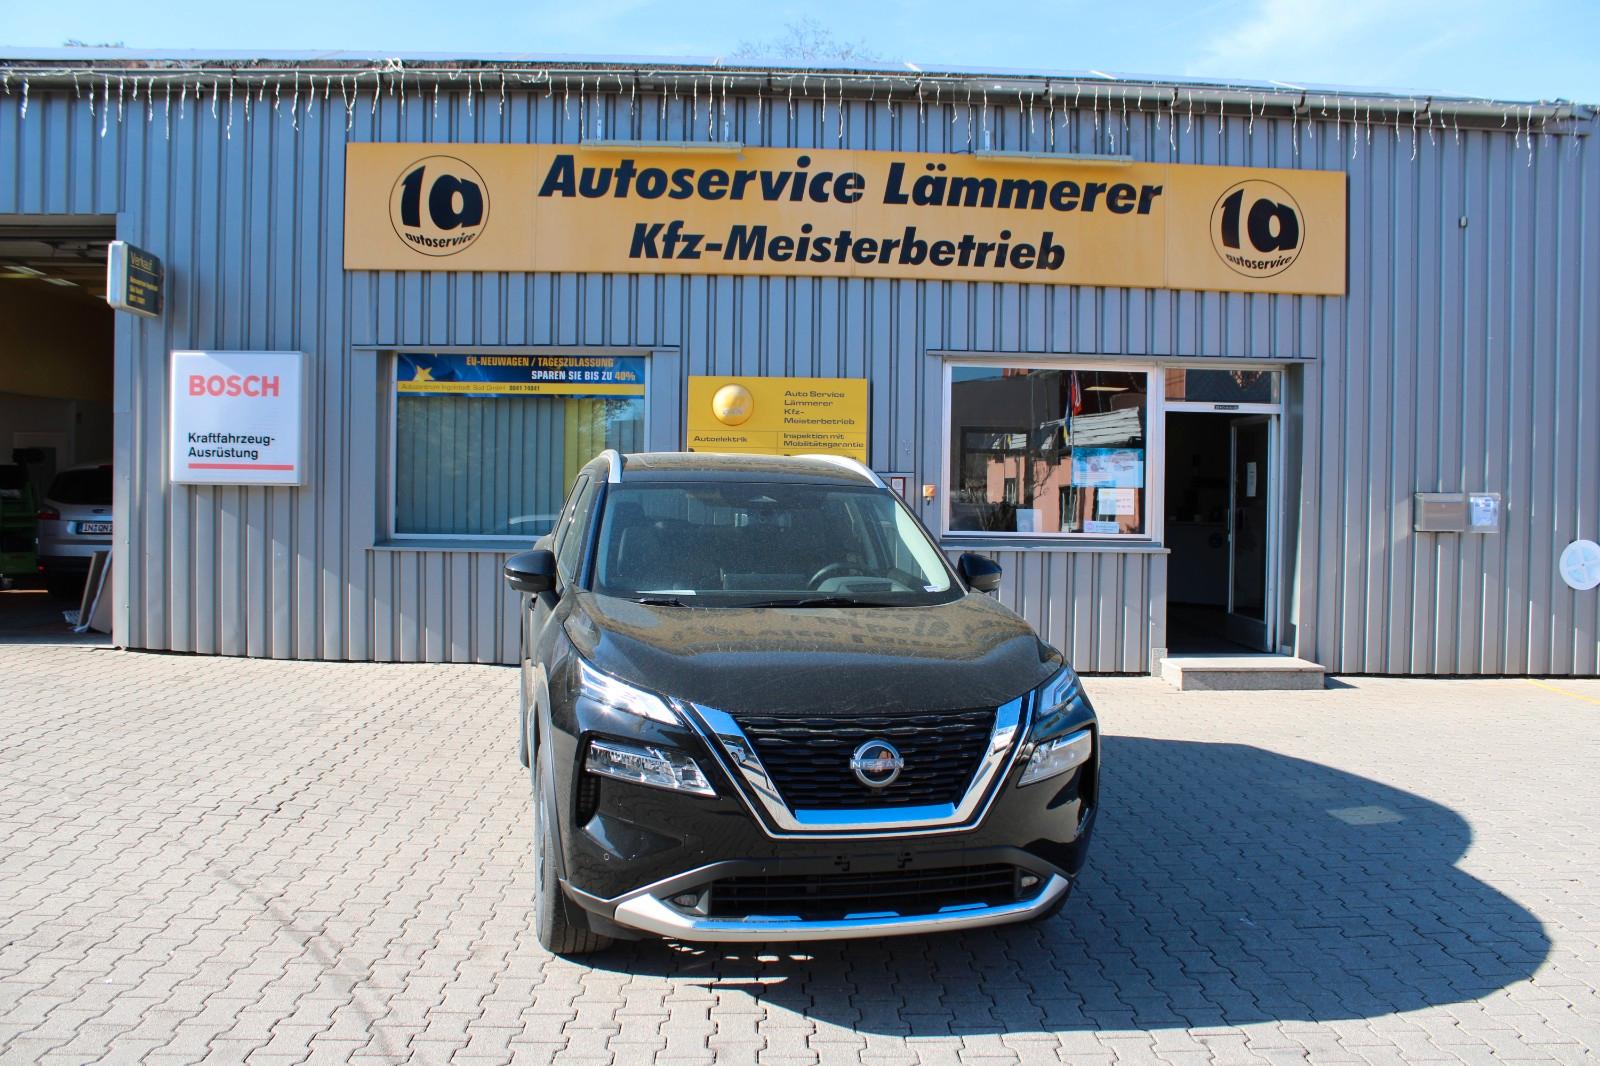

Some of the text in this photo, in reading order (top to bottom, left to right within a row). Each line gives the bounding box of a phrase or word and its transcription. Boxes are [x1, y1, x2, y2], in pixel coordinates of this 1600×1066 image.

[538, 154, 1163, 215] Autoservice Lämmerer
[404, 231, 477, 248] autoservice
[628, 220, 1067, 271] Kfz-Meisterbetrieb
[1225, 252, 1293, 270] autoservice
[466, 356, 529, 368] EU-NEUWAGEN
[538, 356, 614, 369] TAGESZULASSUNG
[531, 370, 566, 381] SPAREN
[568, 371, 583, 381] SIE
[584, 371, 600, 382] BIS
[601, 371, 613, 382] ZU
[188, 374, 280, 398] BOSCH
[784, 390, 846, 399] Auto Service
[784, 399, 834, 407] Lämmerer
[784, 408, 805, 416] Kfz-
[783, 417, 856, 426] Meisterbetrieb
[188, 432, 276, 447] Kraftfahrzeug-
[693, 435, 748, 443] Autoelektrik
[783, 432, 845, 441] Inspektion mit
[783, 440, 864, 449] Mobilitätsgarantie
[187, 446, 259, 461] Ausrüstung
[850, 758, 905, 769] NISSAN
